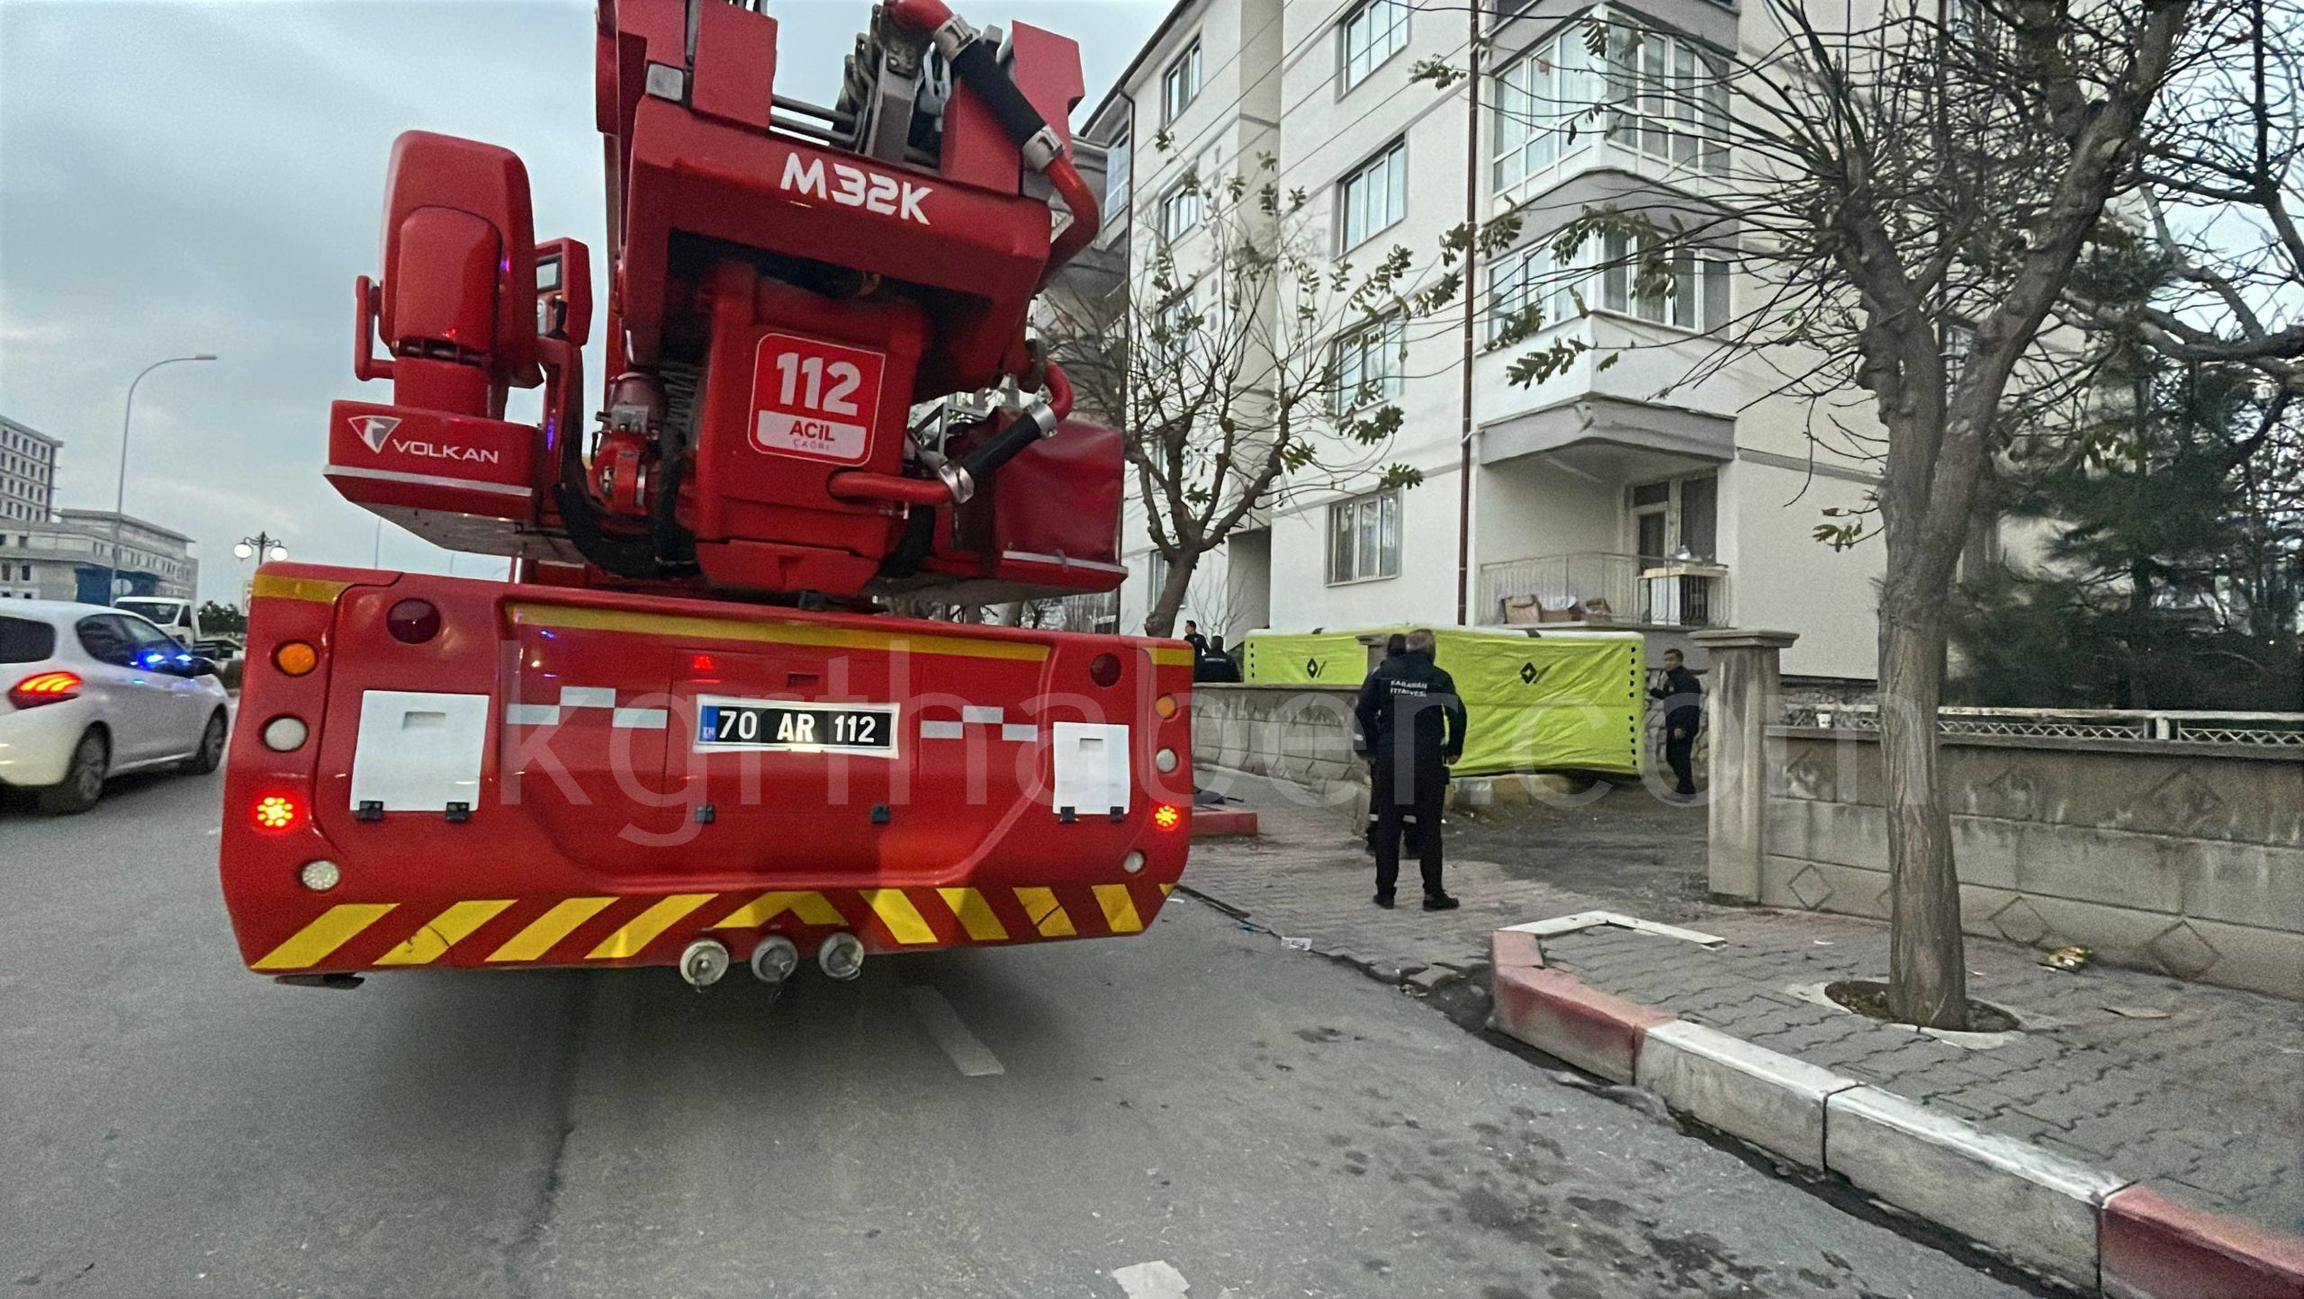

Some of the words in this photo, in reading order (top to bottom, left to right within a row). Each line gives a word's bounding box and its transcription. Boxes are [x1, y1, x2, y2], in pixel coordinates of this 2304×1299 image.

[780, 152, 933, 225] M32K
[776, 353, 862, 416] 112
[393, 438, 499, 464] VOLKAN
[719, 710, 758, 740] 70
[776, 713, 815, 743] AR
[834, 715, 876, 743] 112
